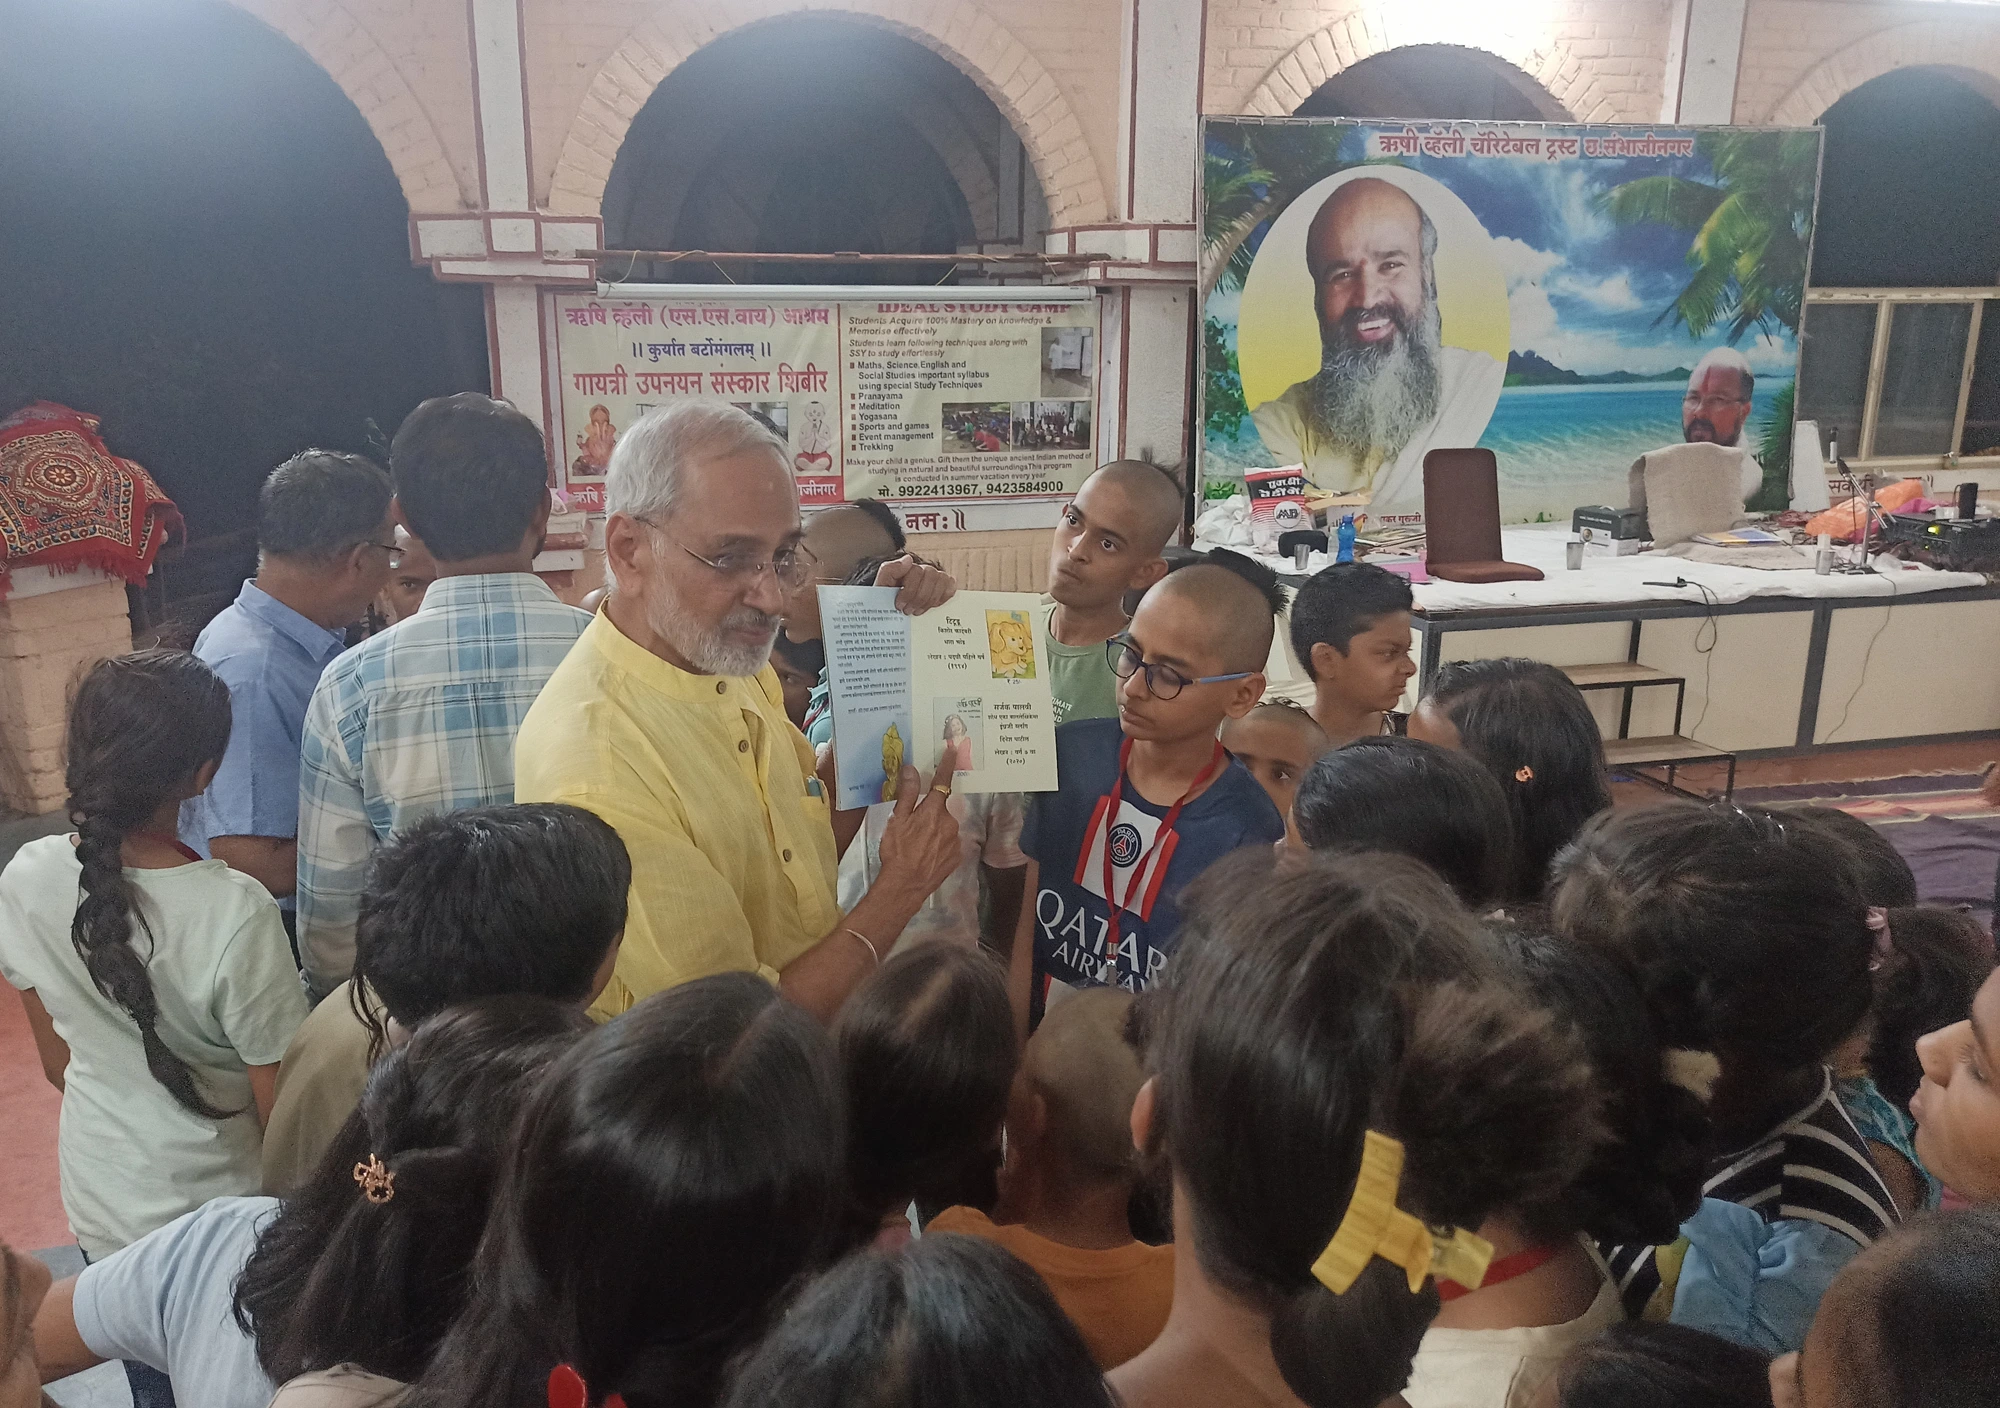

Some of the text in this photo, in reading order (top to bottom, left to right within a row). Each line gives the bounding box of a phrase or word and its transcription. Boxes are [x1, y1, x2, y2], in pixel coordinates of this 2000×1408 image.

[1379, 128, 1419, 153] ऋषी
[1424, 128, 1466, 154] व्हॅली
[1546, 138, 1578, 160] ट्रस्ट
[565, 302, 608, 326] ऋषि
[660, 305, 776, 329] (एस.एस.वाय)
[783, 307, 830, 325] आश्रम
[849, 316, 887, 325] Students
[889, 317, 923, 326] Acquire
[926, 316, 948, 325] 100%
[950, 316, 984, 326] Mastery
[999, 316, 1043, 326] knowledge
[1046, 316, 1052, 324] &
[849, 326, 938, 336] Memorise effectively
[849, 338, 1028, 349] Students learn following techniques along with
[849, 349, 867, 358] SSY
[878, 349, 900, 359] study
[902, 349, 945, 358] effortlessly
[857, 361, 885, 370] Maths,
[951, 359, 966, 368] and
[573, 362, 829, 396] गायत्री उपनयन संस्कार शिबीर
[858, 370, 990, 381] Social Studies important syllabus
[858, 381, 983, 391] using special Study Techniques
[858, 392, 903, 401] Pranayama
[858, 402, 901, 411] Meditation
[858, 413, 898, 422] Yogasana
[859, 423, 930, 432] Sports and games
[859, 432, 935, 442] Event management
[859, 442, 894, 452] Trekking
[846, 458, 866, 466] Make
[867, 458, 884, 467] your
[885, 457, 903, 465] child
[910, 457, 936, 466] genius.
[937, 455, 951, 464] Gift
[952, 455, 969, 464] them
[971, 455, 982, 463] the
[984, 455, 1008, 464] unique
[1010, 454, 1035, 462] ancient
[1036, 453, 1057, 461] Indian
[1058, 452, 1084, 461] method
[1085, 452, 1092, 460] of
[868, 466, 899, 475] studying
[900, 466, 907, 474] in
[909, 465, 934, 473] natural
[935, 465, 948, 473] and
[950, 464, 980, 473] beautiful
[1043, 462, 1073, 471] program
[894, 475, 901, 483] is
[903, 474, 941, 483] conducted
[950, 474, 979, 482] summer
[980, 473, 1009, 481] vacation
[1011, 472, 1030, 481] every
[1031, 472, 1047, 481] year
[878, 481, 1064, 498] मो. 9922413967, 9423584900
[1036, 888, 1169, 990] QATAR
